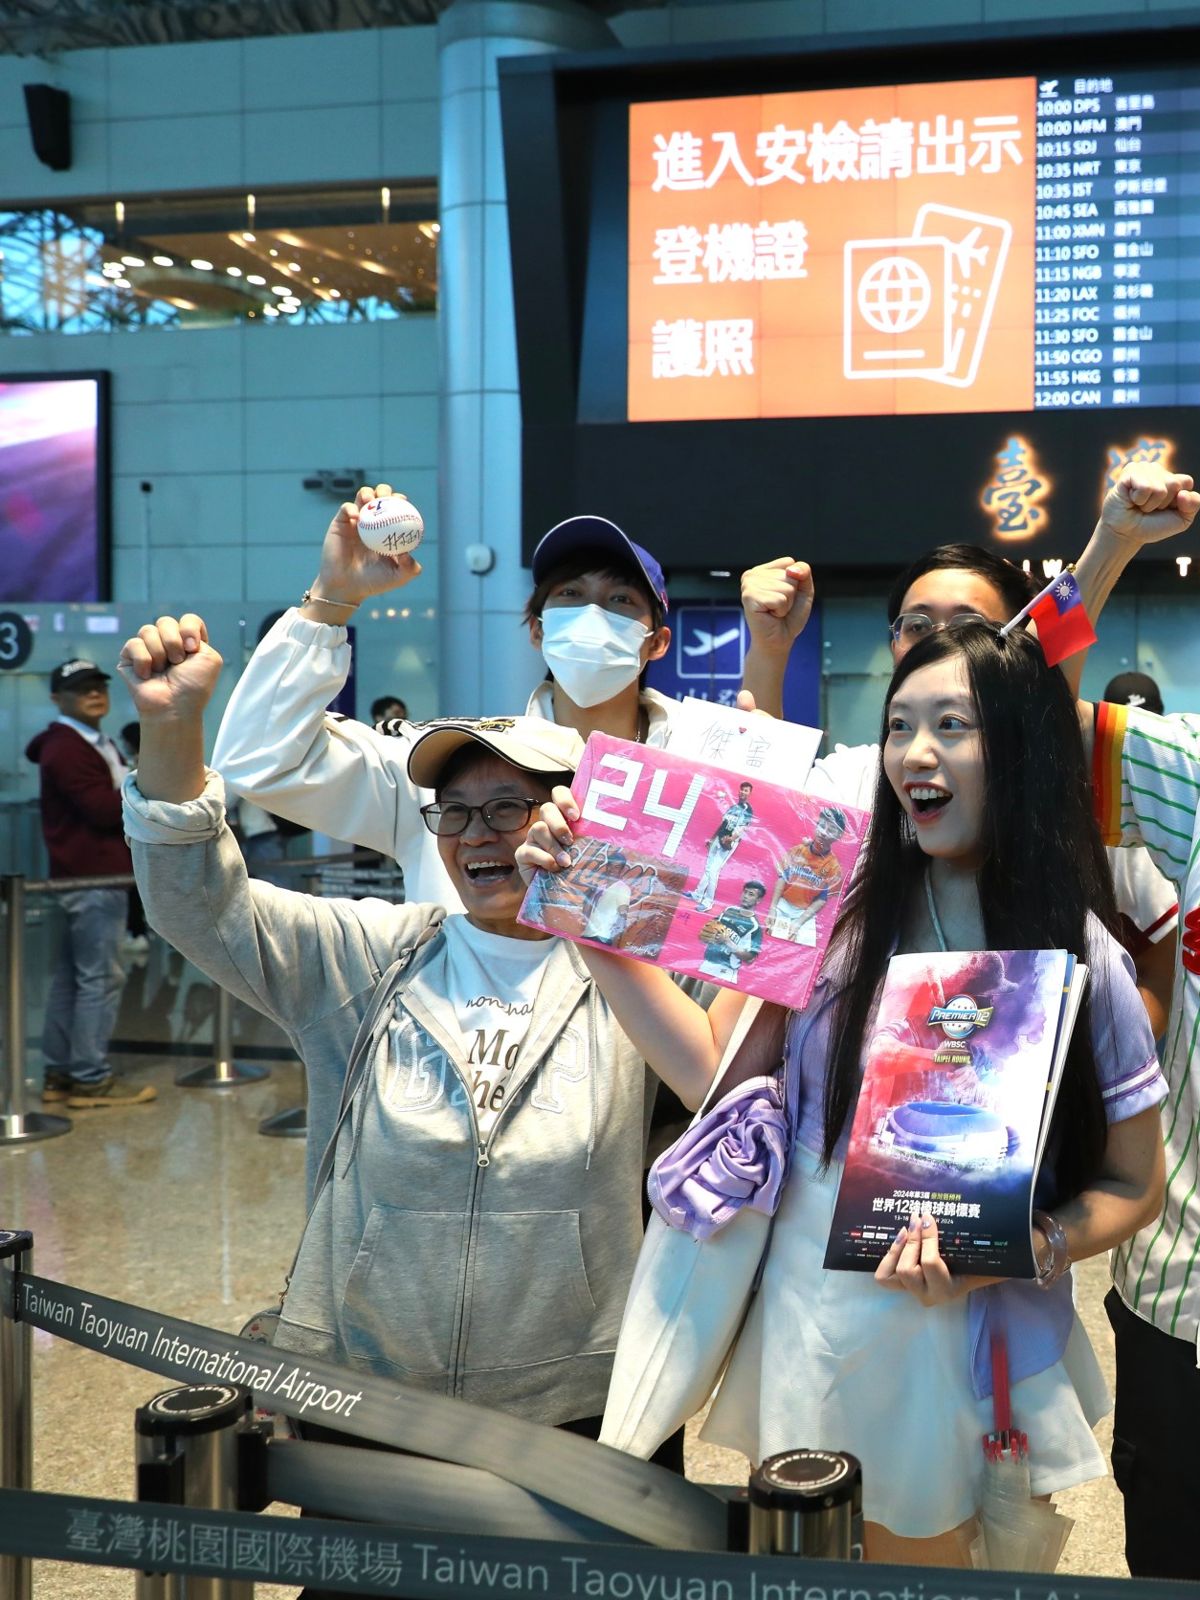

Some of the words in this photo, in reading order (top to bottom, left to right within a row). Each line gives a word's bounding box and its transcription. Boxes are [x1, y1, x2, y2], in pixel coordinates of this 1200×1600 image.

[651, 114, 1023, 192] 進入安檢請出示
[651, 220, 809, 284] 登機證
[651, 318, 755, 379] 護照
[579, 752, 706, 858] 24
[930, 1008, 977, 1021] PREMIER
[944, 1040, 967, 1048] WBSC
[384, 1020, 590, 1115] GP
[22, 1282, 75, 1327] Taiwan
[79, 1301, 150, 1352] Taoyuan
[150, 1326, 286, 1393] International
[273, 1366, 364, 1417] Airport
[64, 1507, 403, 1589] 臺灣桃園國際機場
[412, 1543, 549, 1592] Taiwan
[561, 1556, 735, 1600] Taoyuan
